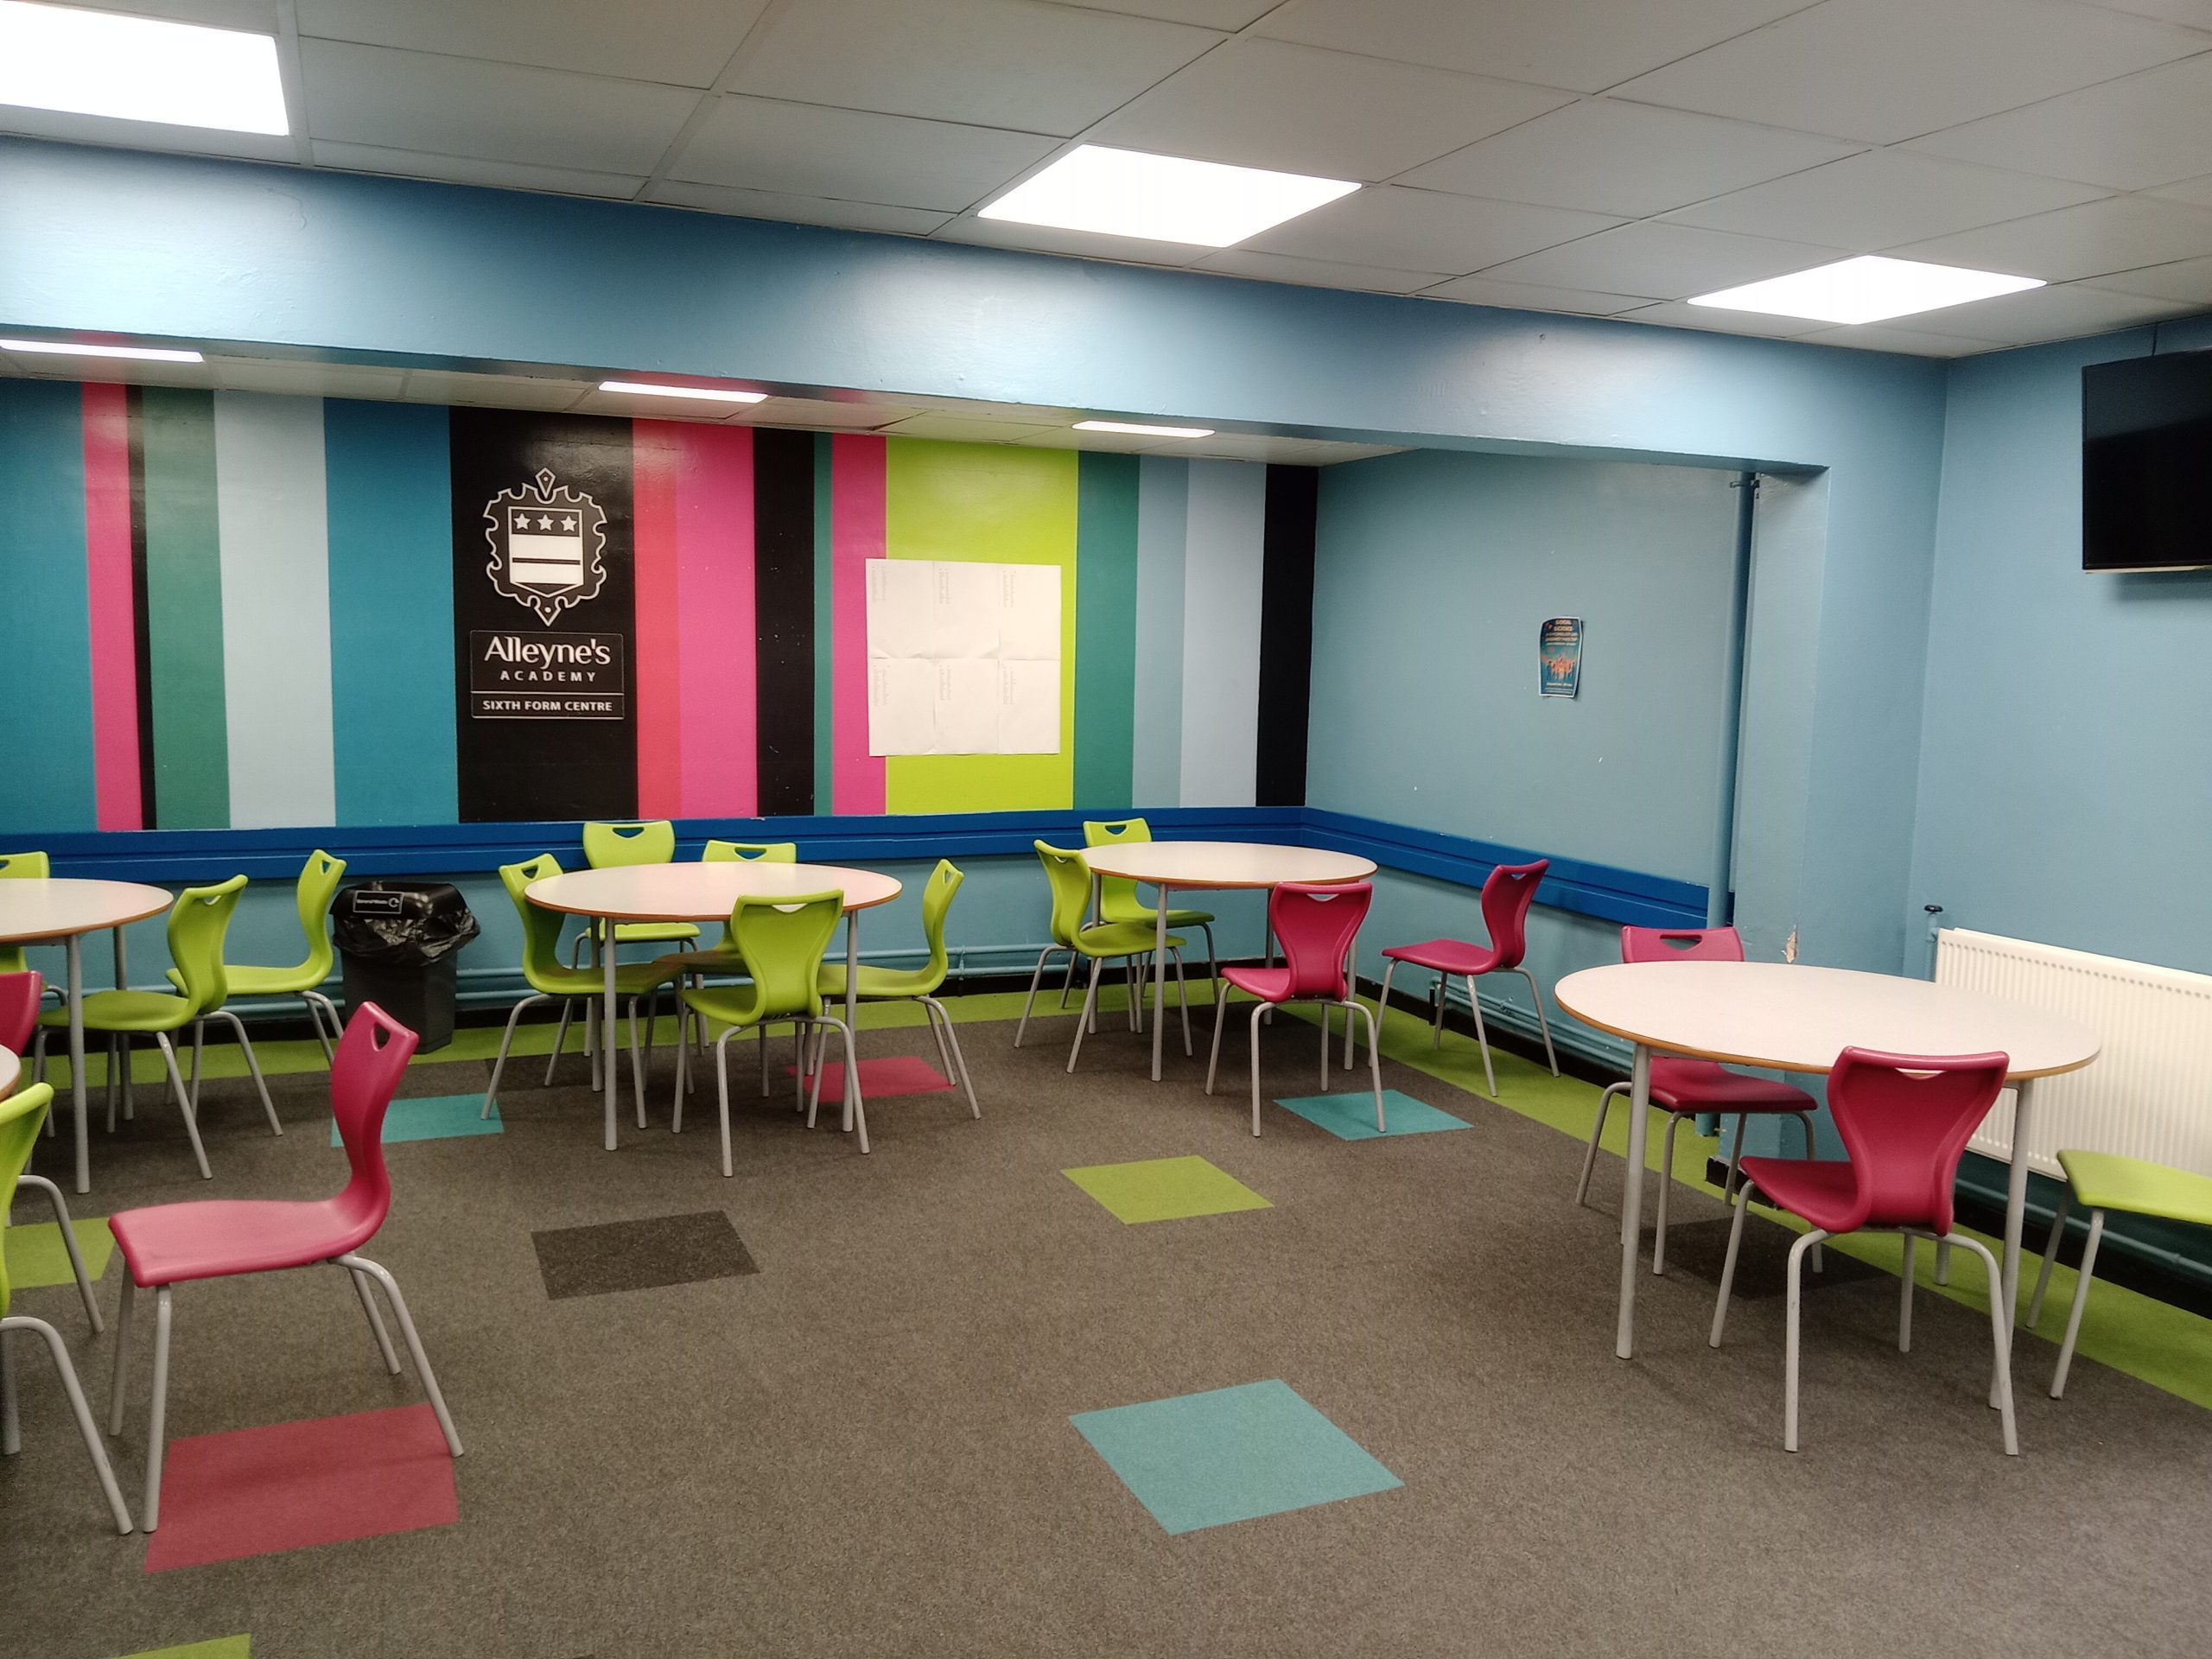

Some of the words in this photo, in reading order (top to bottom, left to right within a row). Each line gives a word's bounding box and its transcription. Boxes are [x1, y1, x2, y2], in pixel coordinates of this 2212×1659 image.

[484, 636, 612, 670] Alleyne's
[500, 671, 596, 683] ACADEMY
[482, 700, 521, 711] SIXTH
[524, 701, 561, 711] FORM
[564, 701, 613, 712] CENTRE
